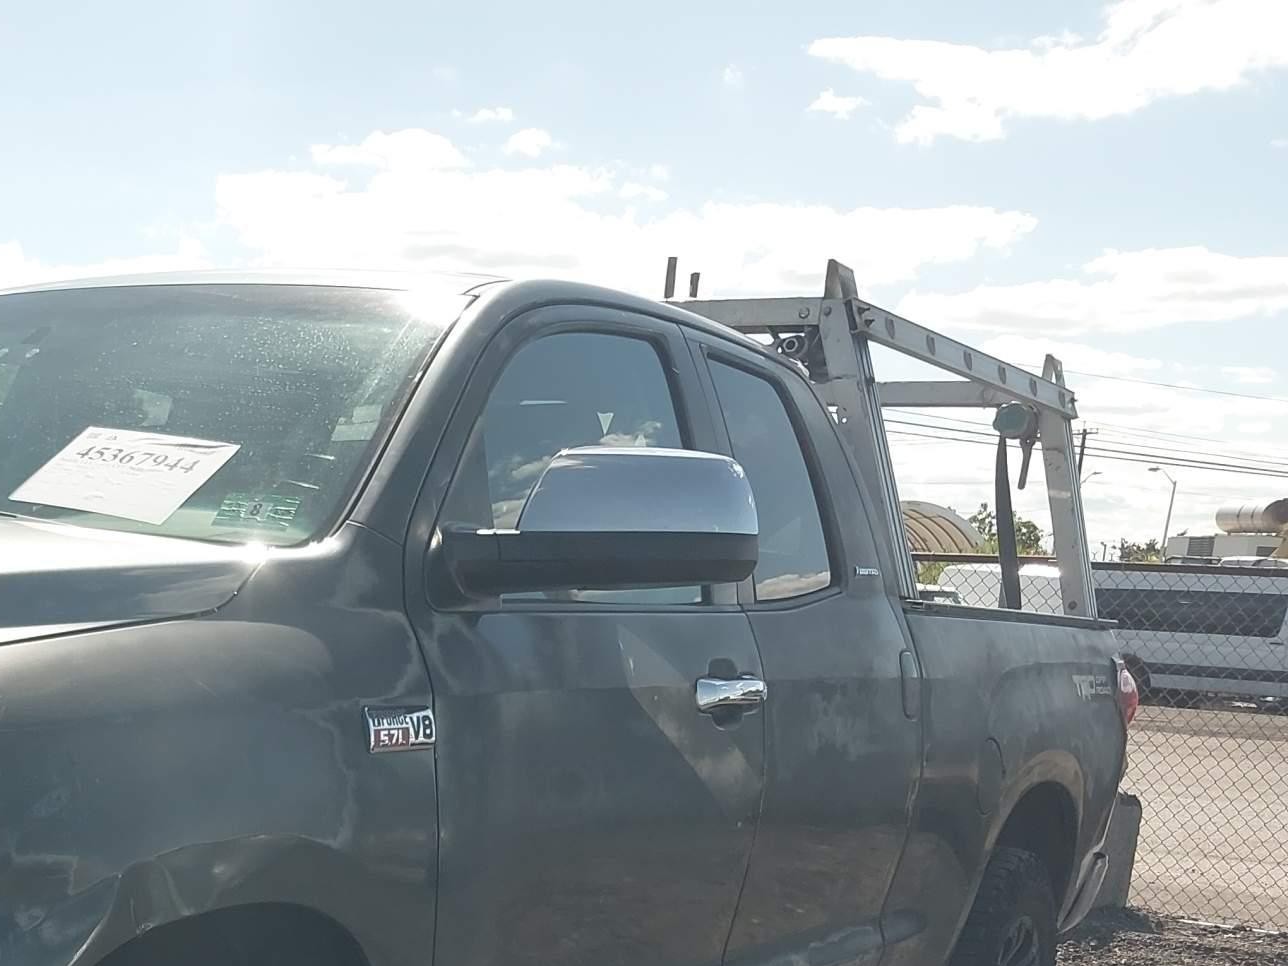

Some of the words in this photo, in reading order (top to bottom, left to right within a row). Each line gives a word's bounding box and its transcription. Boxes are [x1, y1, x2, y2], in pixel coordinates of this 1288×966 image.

[76, 445, 200, 474] 45367944
[249, 503, 264, 516] 8
[409, 714, 434, 741] V8
